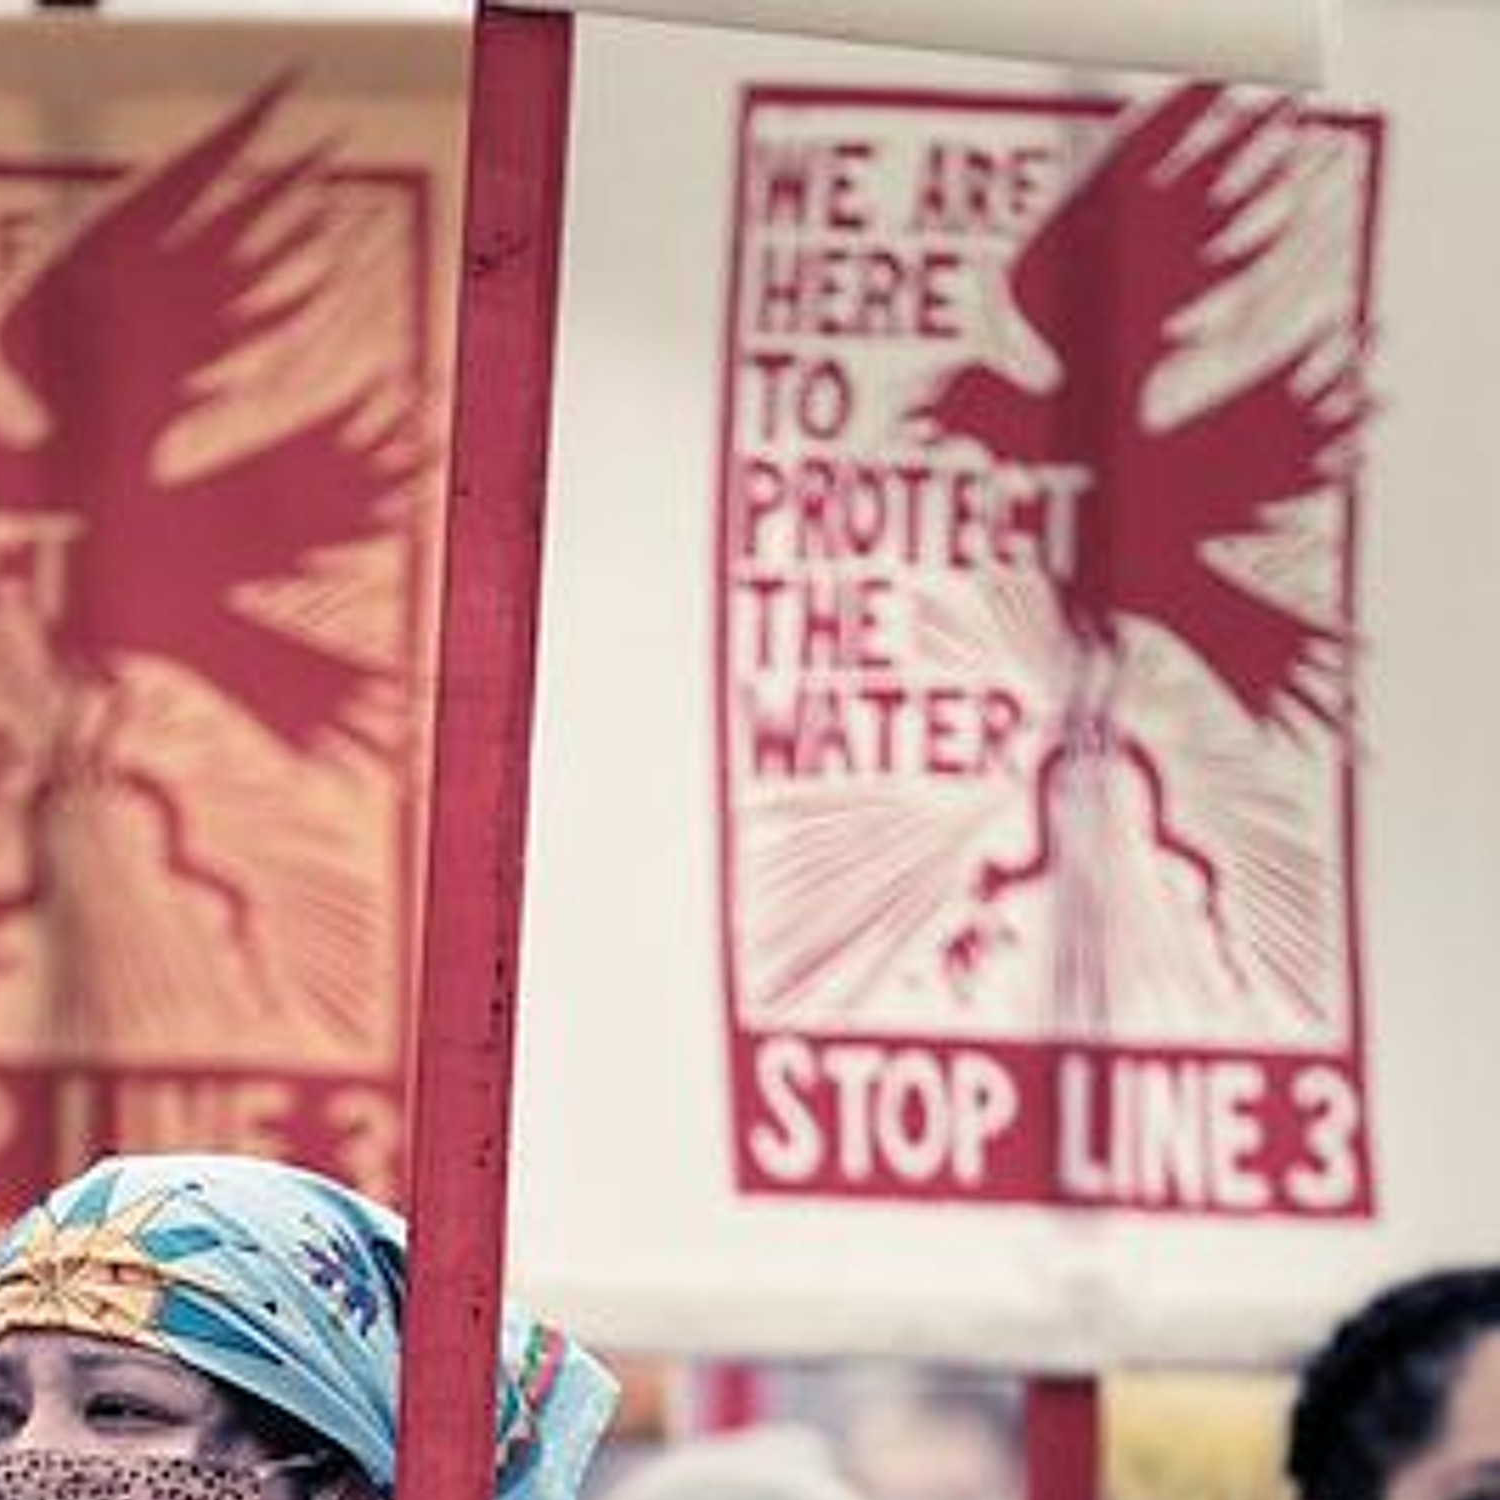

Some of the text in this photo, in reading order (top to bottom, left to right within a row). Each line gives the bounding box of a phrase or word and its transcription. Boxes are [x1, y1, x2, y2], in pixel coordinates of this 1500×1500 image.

[755, 144, 1050, 233] WE ARE
[758, 248, 962, 339] HERE
[750, 351, 851, 440] TO
[738, 459, 1093, 578] PROTECT
[743, 577, 895, 669] THE
[747, 686, 1023, 778] WATER
[750, 1035, 1360, 1210] STOP LINE 3
